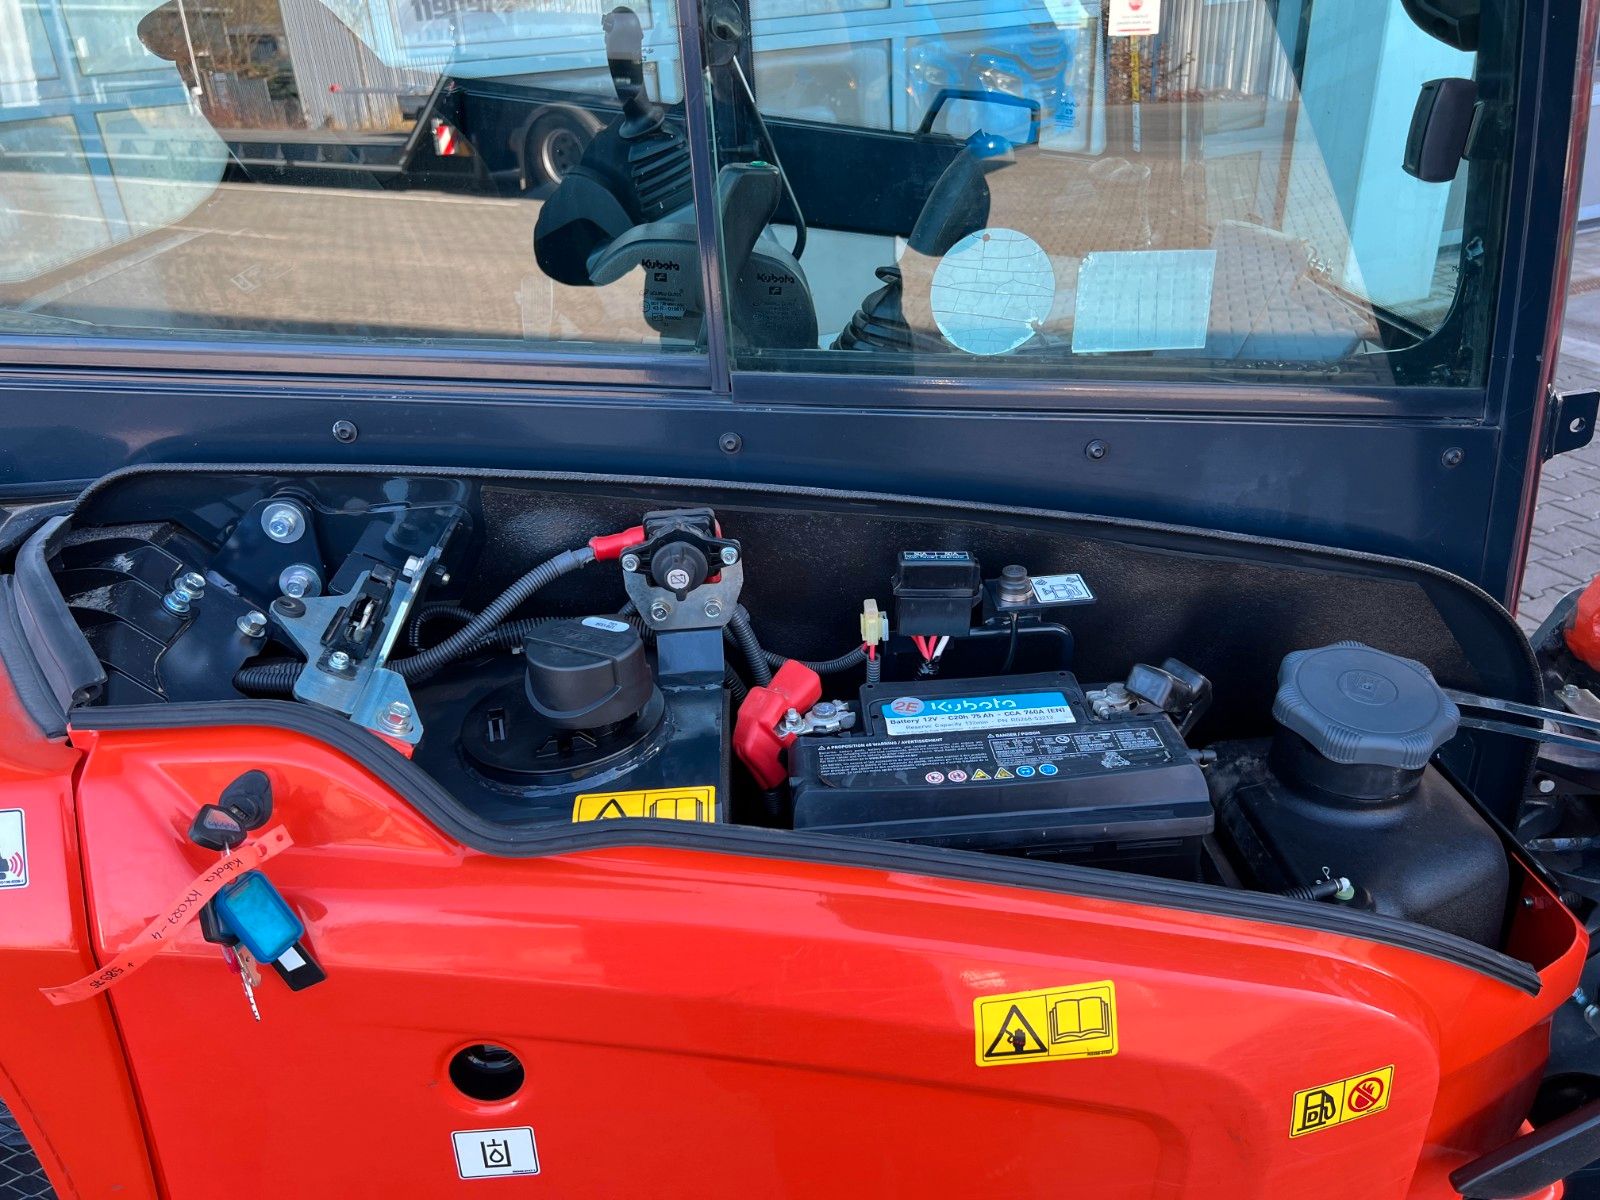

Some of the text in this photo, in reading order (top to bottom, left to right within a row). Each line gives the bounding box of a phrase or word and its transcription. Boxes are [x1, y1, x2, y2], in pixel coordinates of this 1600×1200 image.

[642, 259, 680, 271] Kubota
[757, 272, 795, 284] Kubota
[894, 701, 919, 713] 2E
[931, 698, 1017, 713] Kubota
[890, 718, 920, 726] Battery
[934, 721, 962, 729] Capacity
[872, 740, 898, 748] WARNING
[204, 857, 243, 883] Kubota
